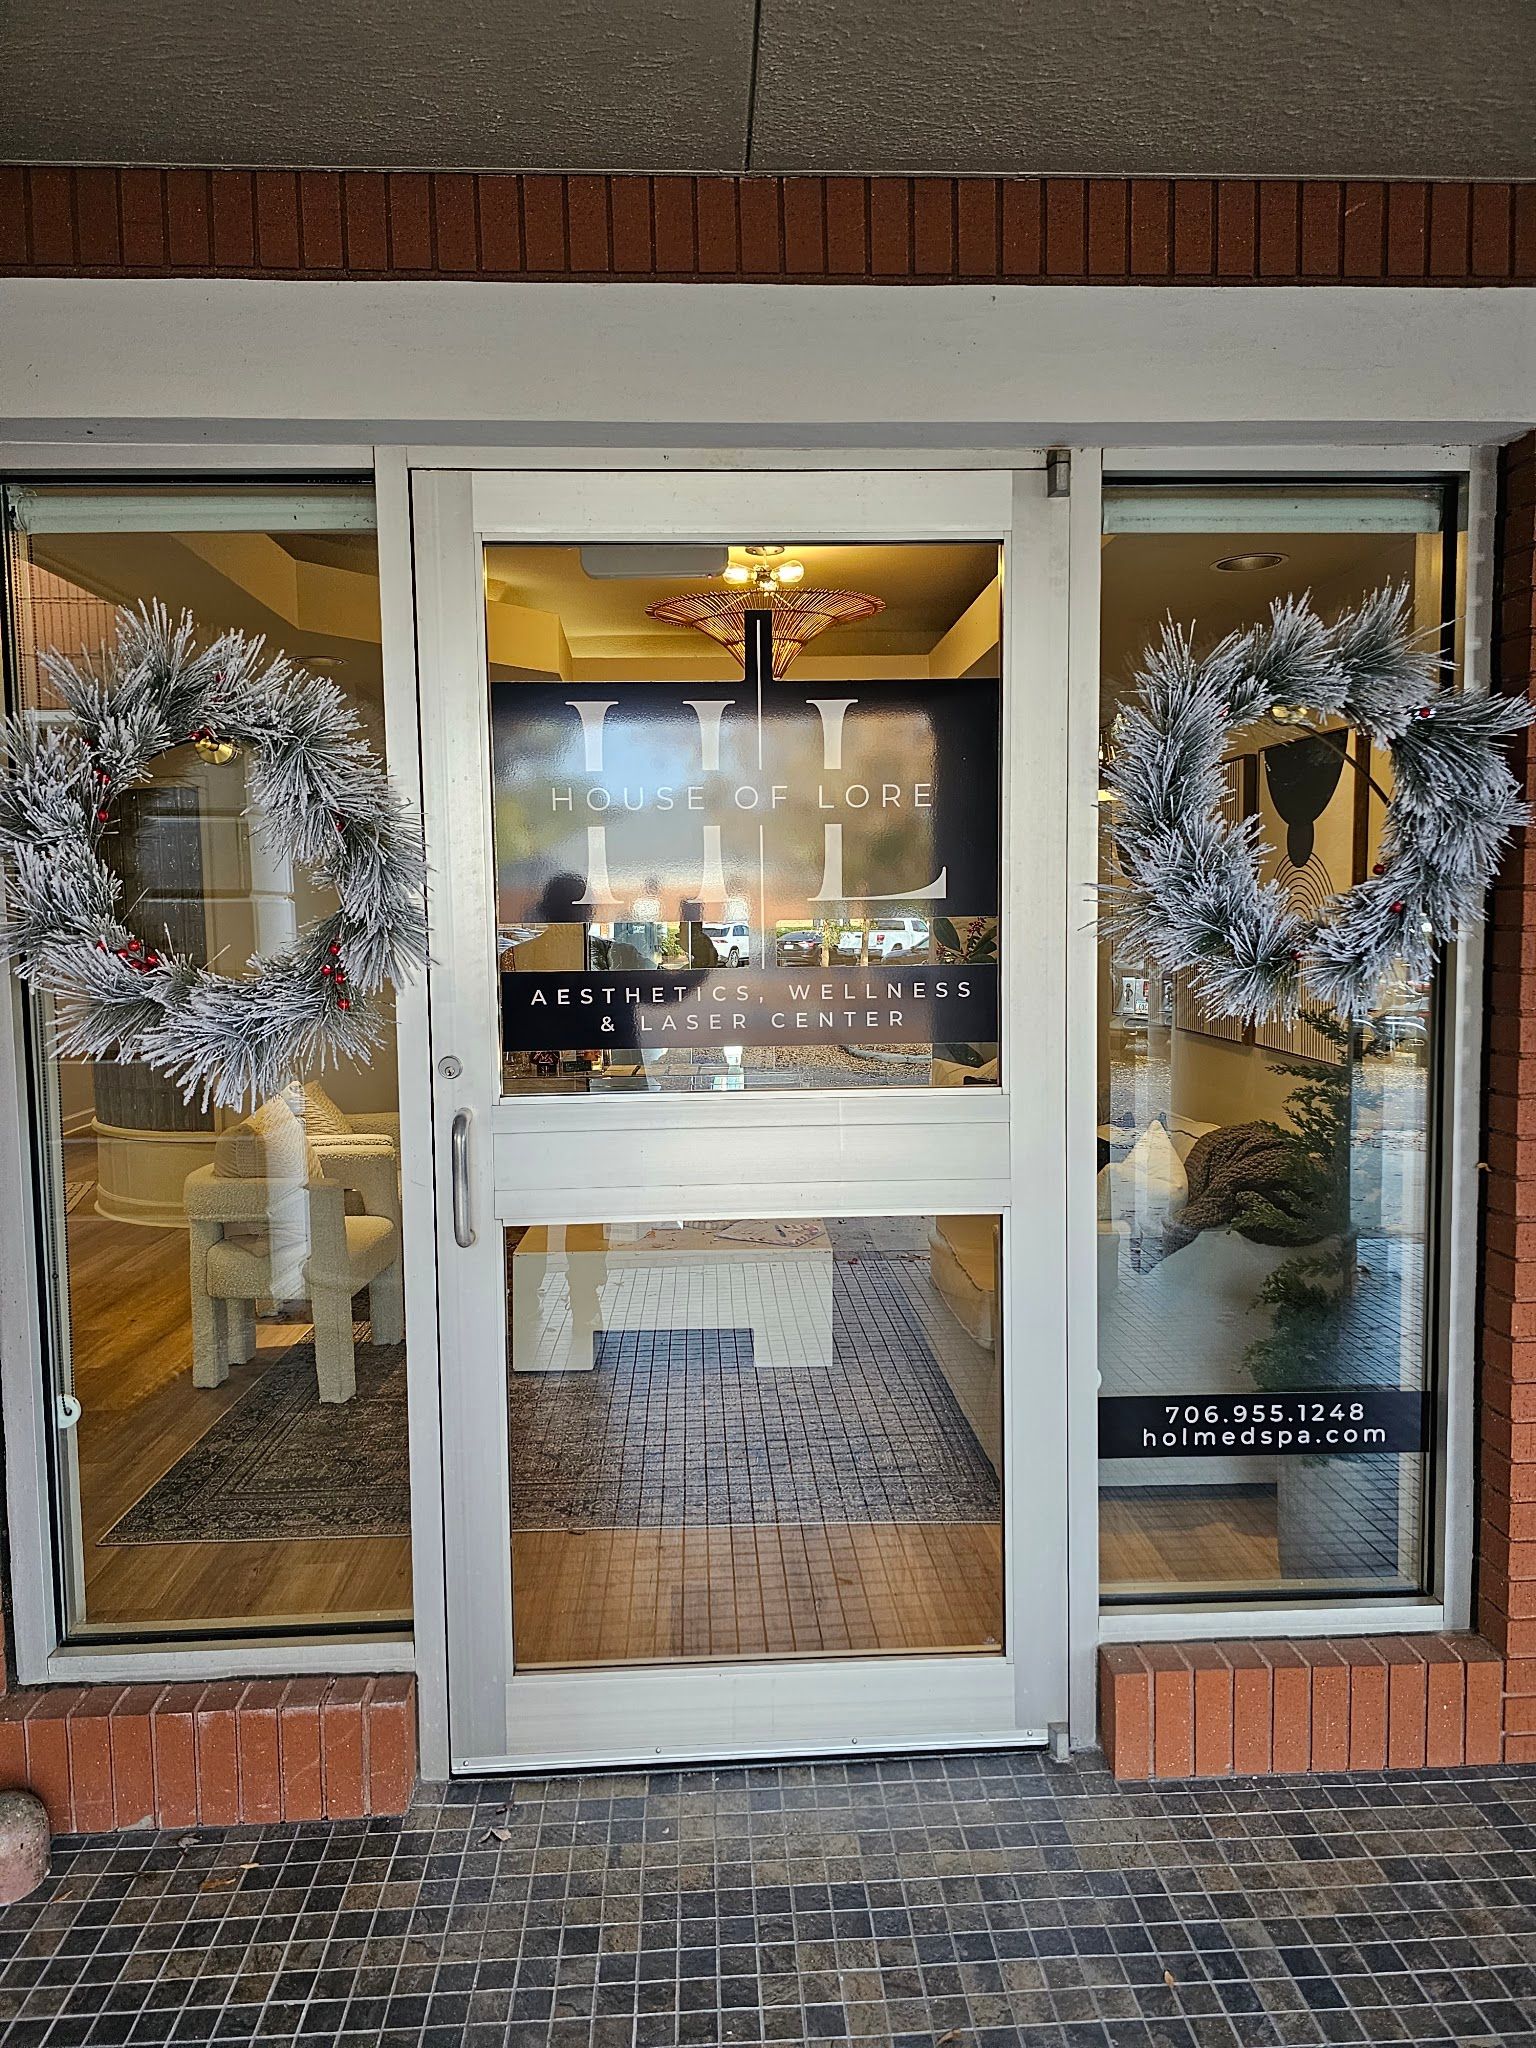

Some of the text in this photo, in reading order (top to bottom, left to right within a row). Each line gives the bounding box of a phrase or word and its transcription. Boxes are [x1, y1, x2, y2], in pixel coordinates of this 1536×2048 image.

[551, 782, 933, 812] HOUSE OF LORE
[530, 980, 973, 1006] AESTHETICS, WELLNESS
[600, 1009, 905, 1033] & LASER CENTER
[1165, 1402, 1366, 1425] 706.955.1248
[1142, 1426, 1387, 1449] holmedspa.com
